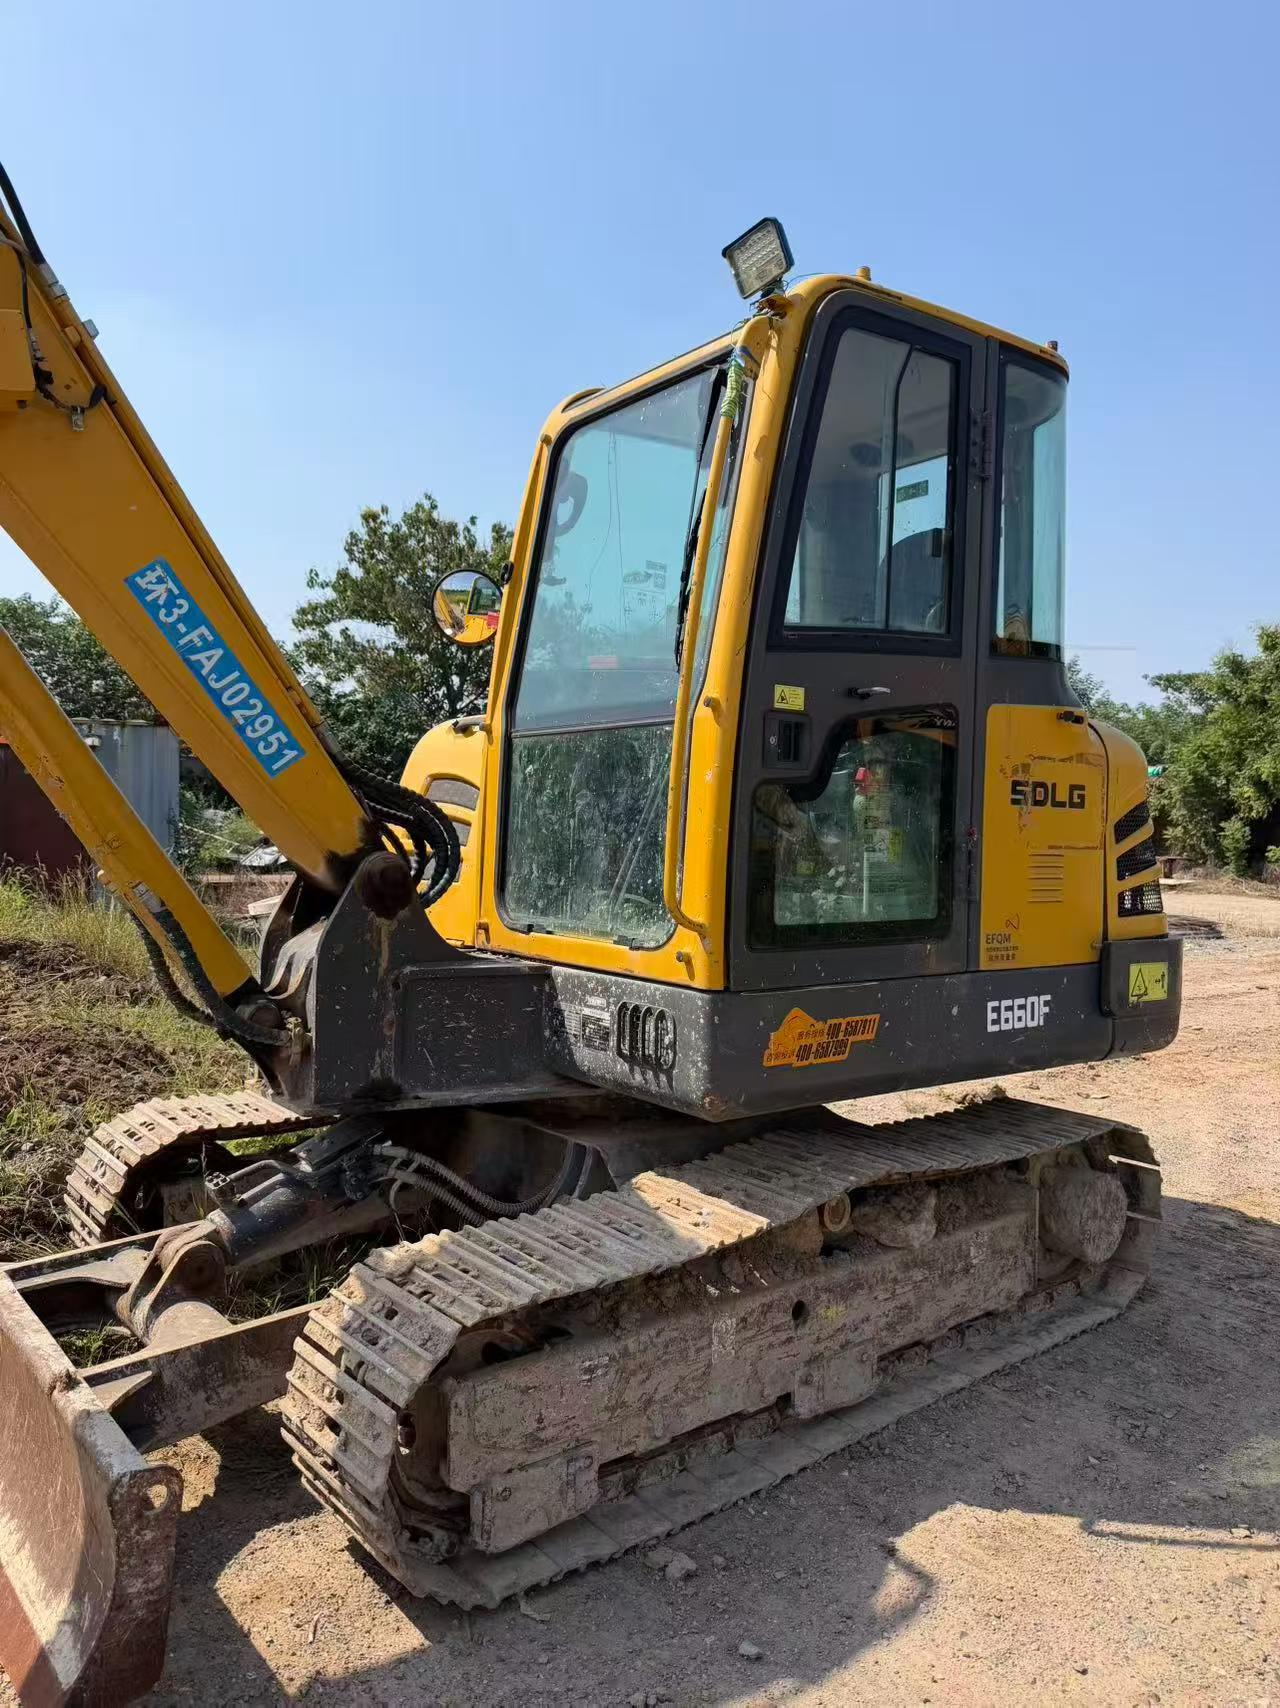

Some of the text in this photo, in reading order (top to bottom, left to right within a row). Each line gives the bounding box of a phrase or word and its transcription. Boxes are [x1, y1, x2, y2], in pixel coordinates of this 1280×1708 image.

[135, 565, 298, 771] 环3-FAJ02951
[1010, 779, 1086, 809] SDLG
[985, 933, 1012, 945] EFQM
[987, 994, 1052, 1033] E660F
